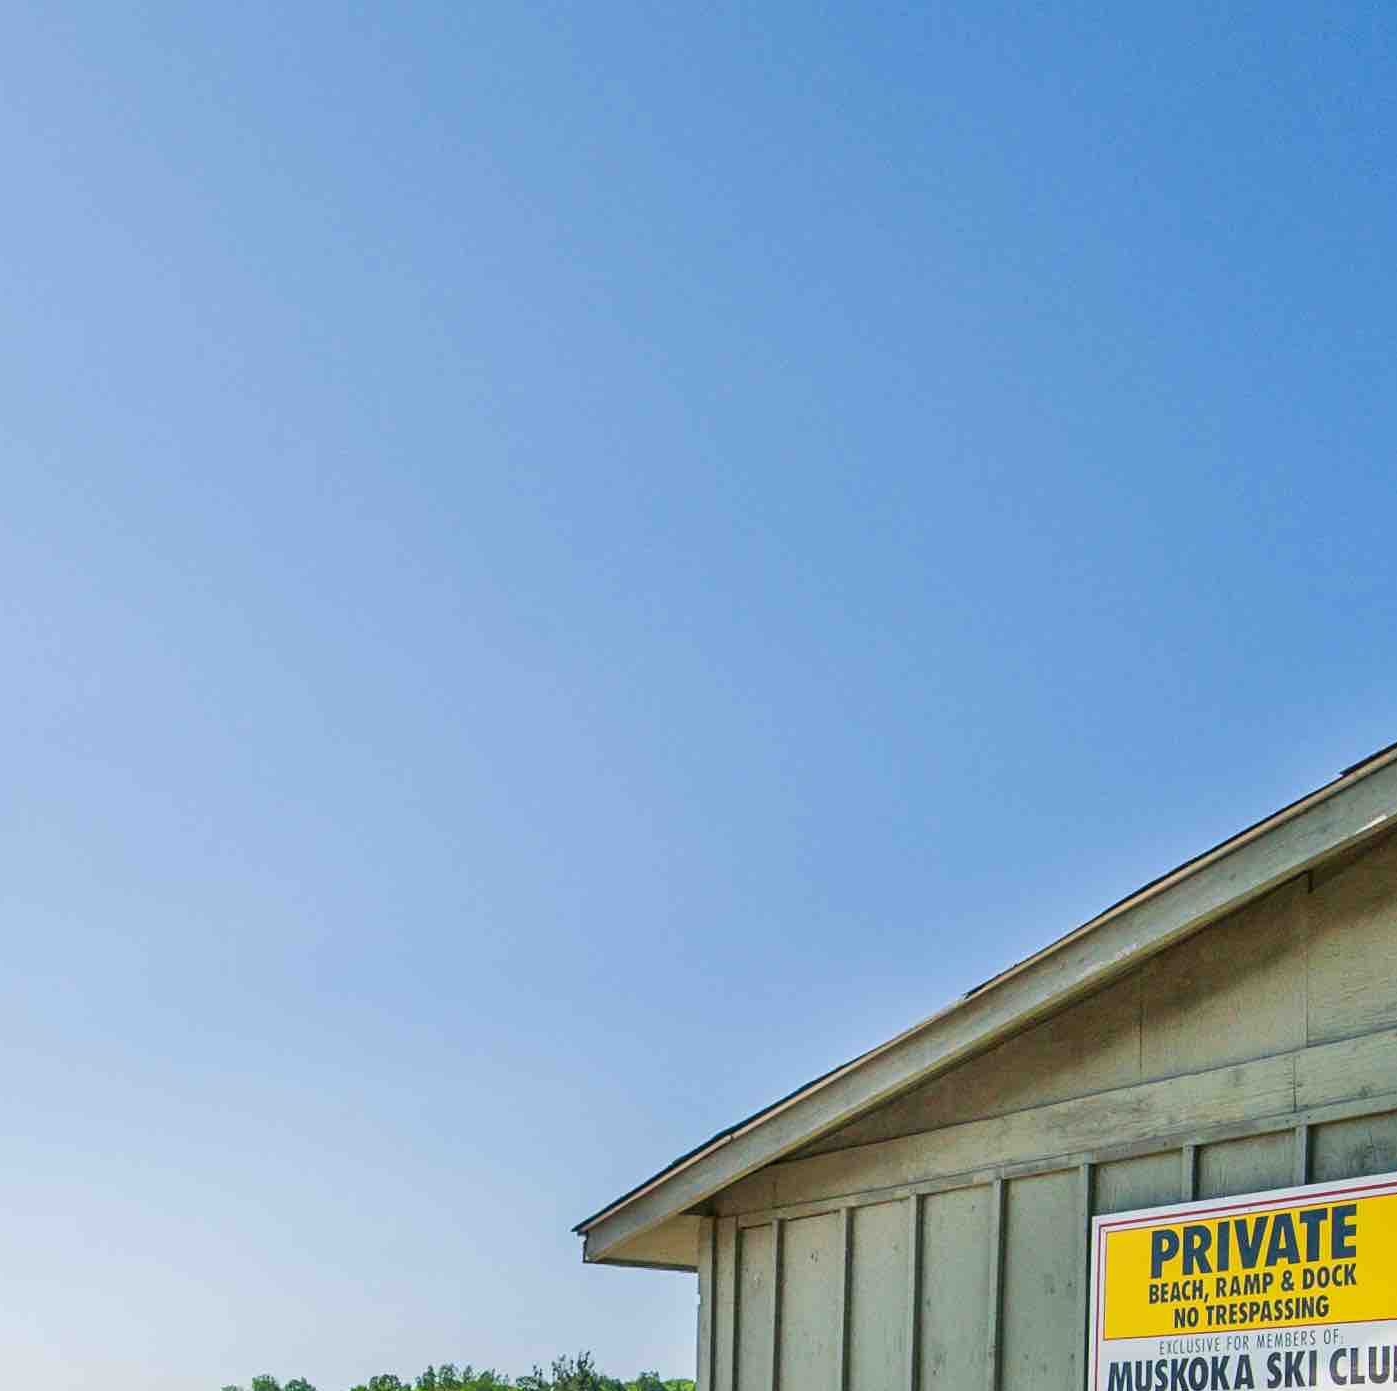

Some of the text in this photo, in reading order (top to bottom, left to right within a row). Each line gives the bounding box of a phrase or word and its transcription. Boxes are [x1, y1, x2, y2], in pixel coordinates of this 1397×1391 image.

[1150, 1204, 1357, 1279] PRIVATE
[1149, 1263, 1357, 1304] BEACH, RAMP & DOCK
[1174, 1295, 1330, 1328] NO TRESPASSING
[1159, 1335, 1221, 1356] EXCLUSIVE
[1227, 1334, 1249, 1352] FOR
[1257, 1330, 1316, 1349] MEMBERS
[1266, 1350, 1317, 1389] SKI
